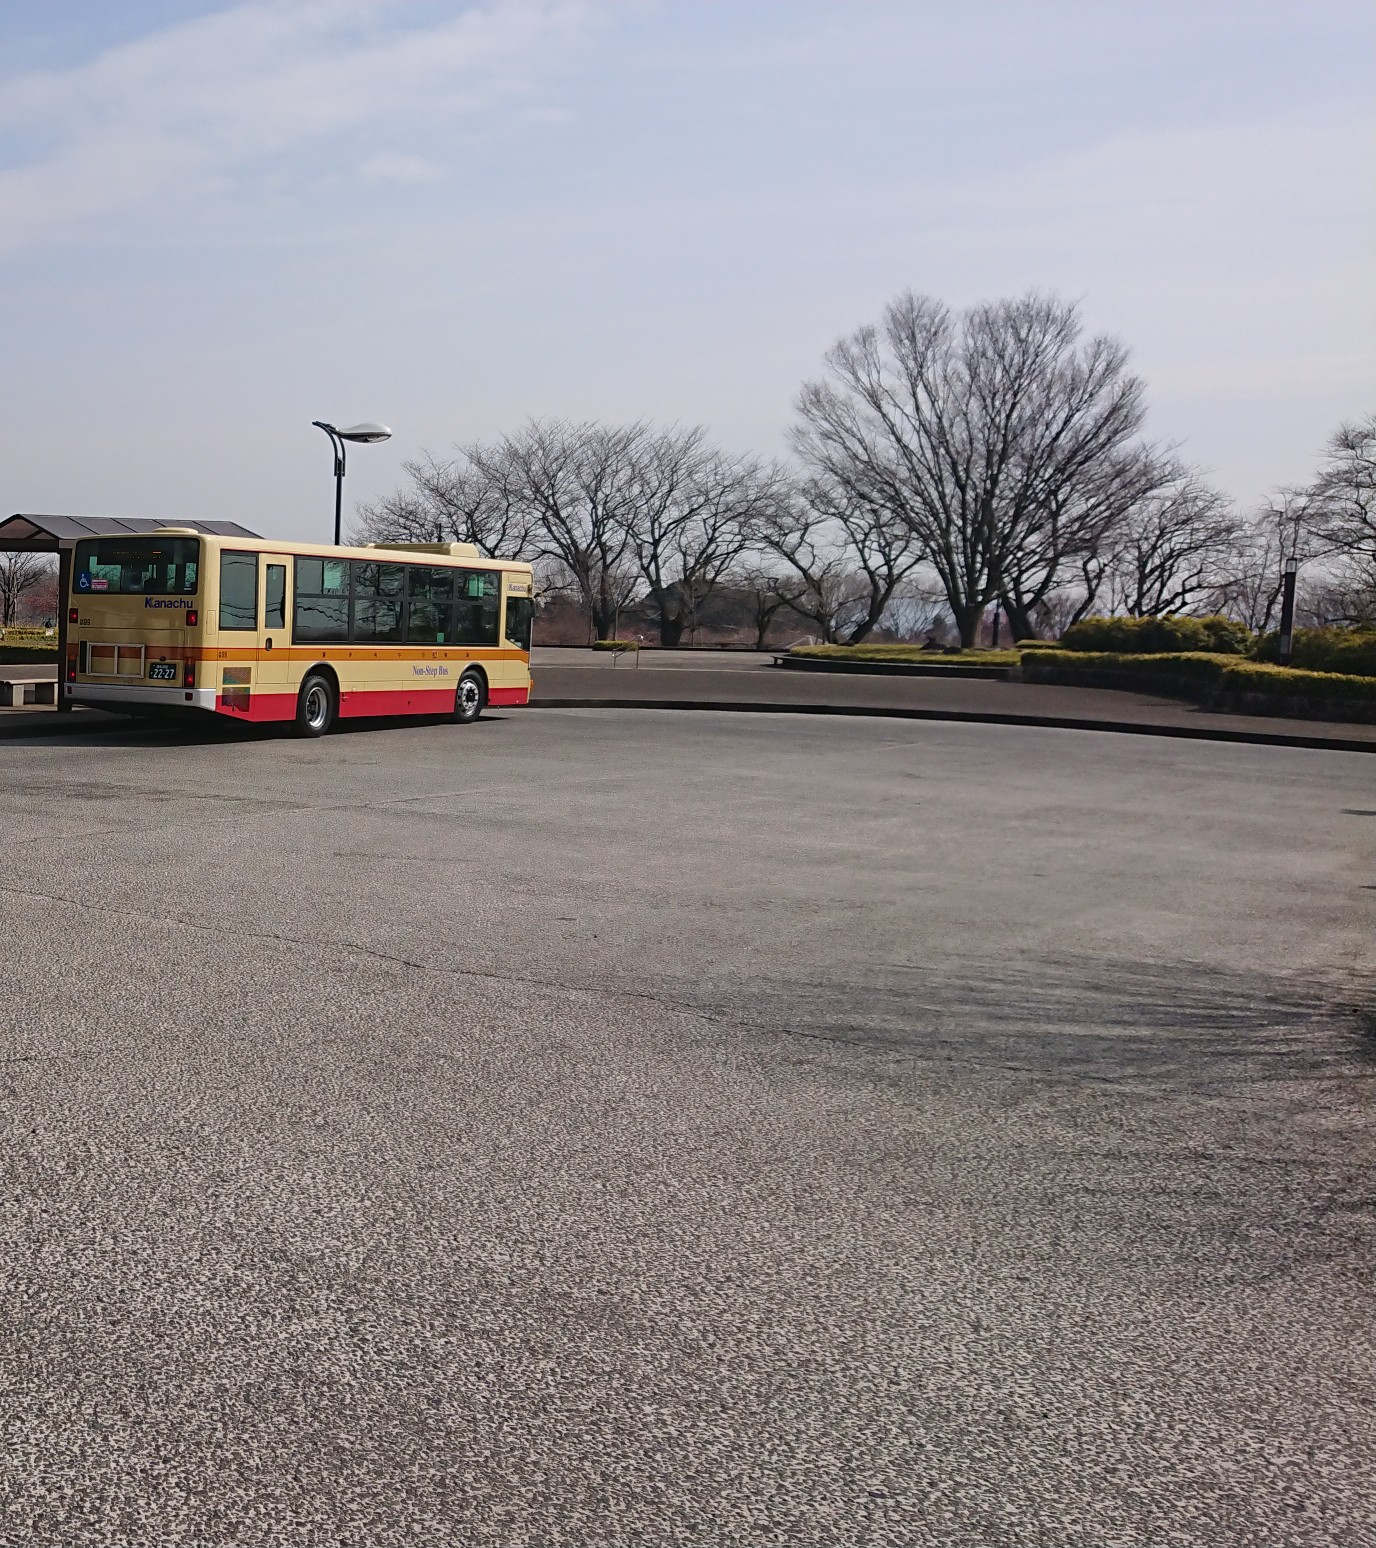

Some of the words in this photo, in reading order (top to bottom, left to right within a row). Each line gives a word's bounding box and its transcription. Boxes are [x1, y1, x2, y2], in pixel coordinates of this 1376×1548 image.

[144, 596, 193, 609] Kanachu
[153, 668, 175, 679] 22-27
[412, 665, 438, 678] Non-Step
[438, 665, 449, 676] Bus
